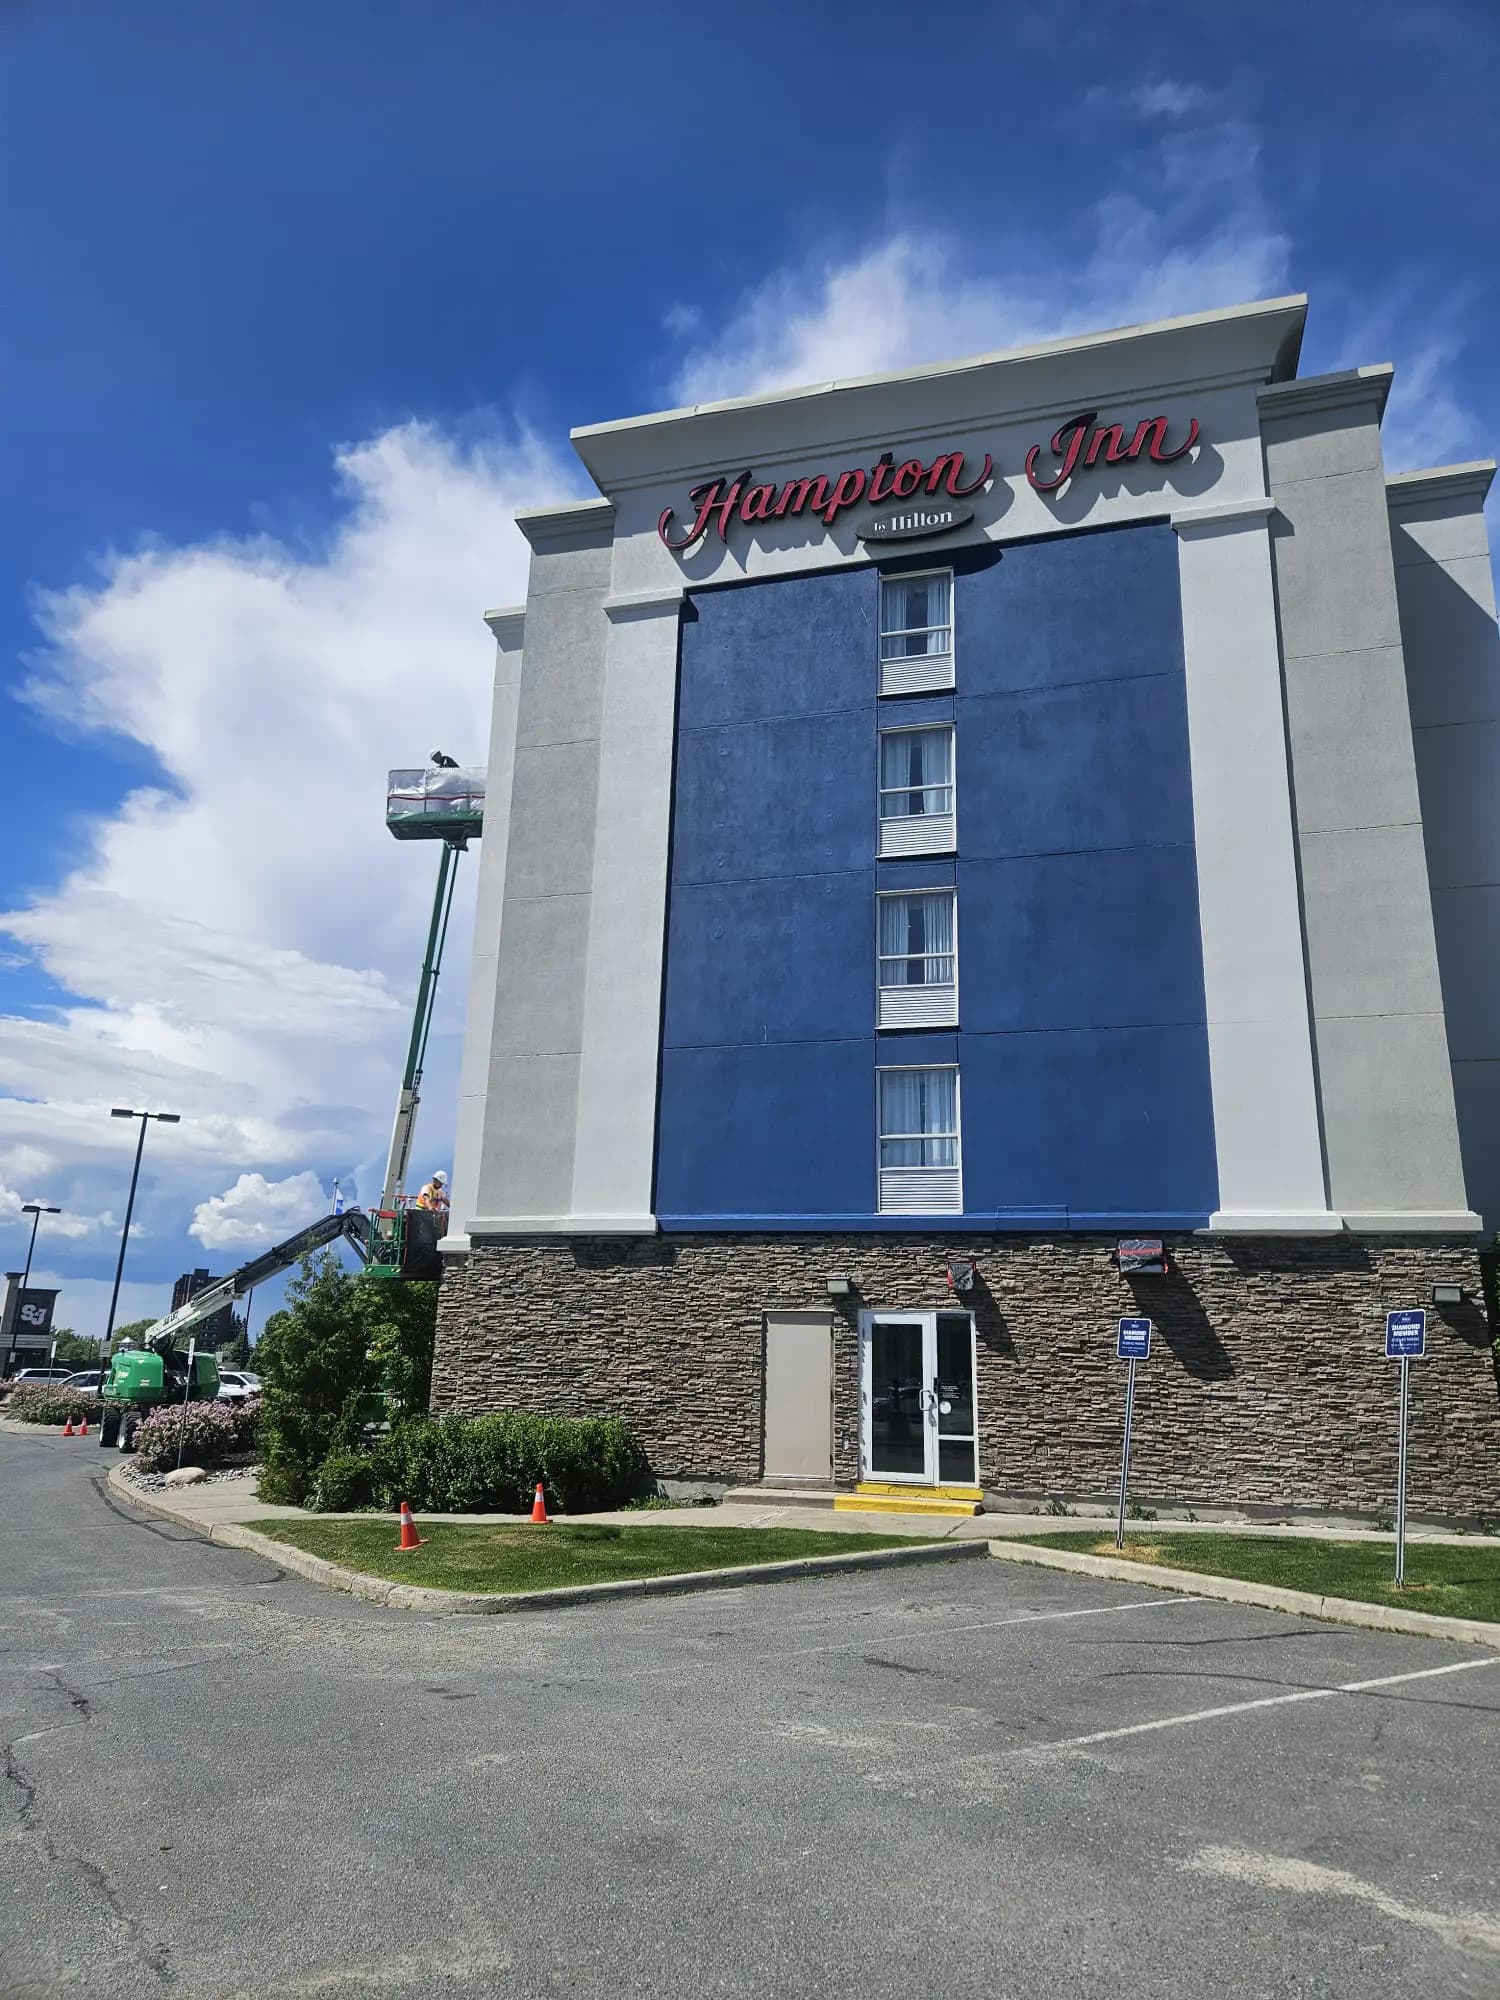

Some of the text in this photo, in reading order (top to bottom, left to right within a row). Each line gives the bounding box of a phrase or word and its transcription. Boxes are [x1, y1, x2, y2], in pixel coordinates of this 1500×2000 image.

[657, 412, 1199, 549] Hampton Inn
[874, 511, 953, 533] by Hilton
